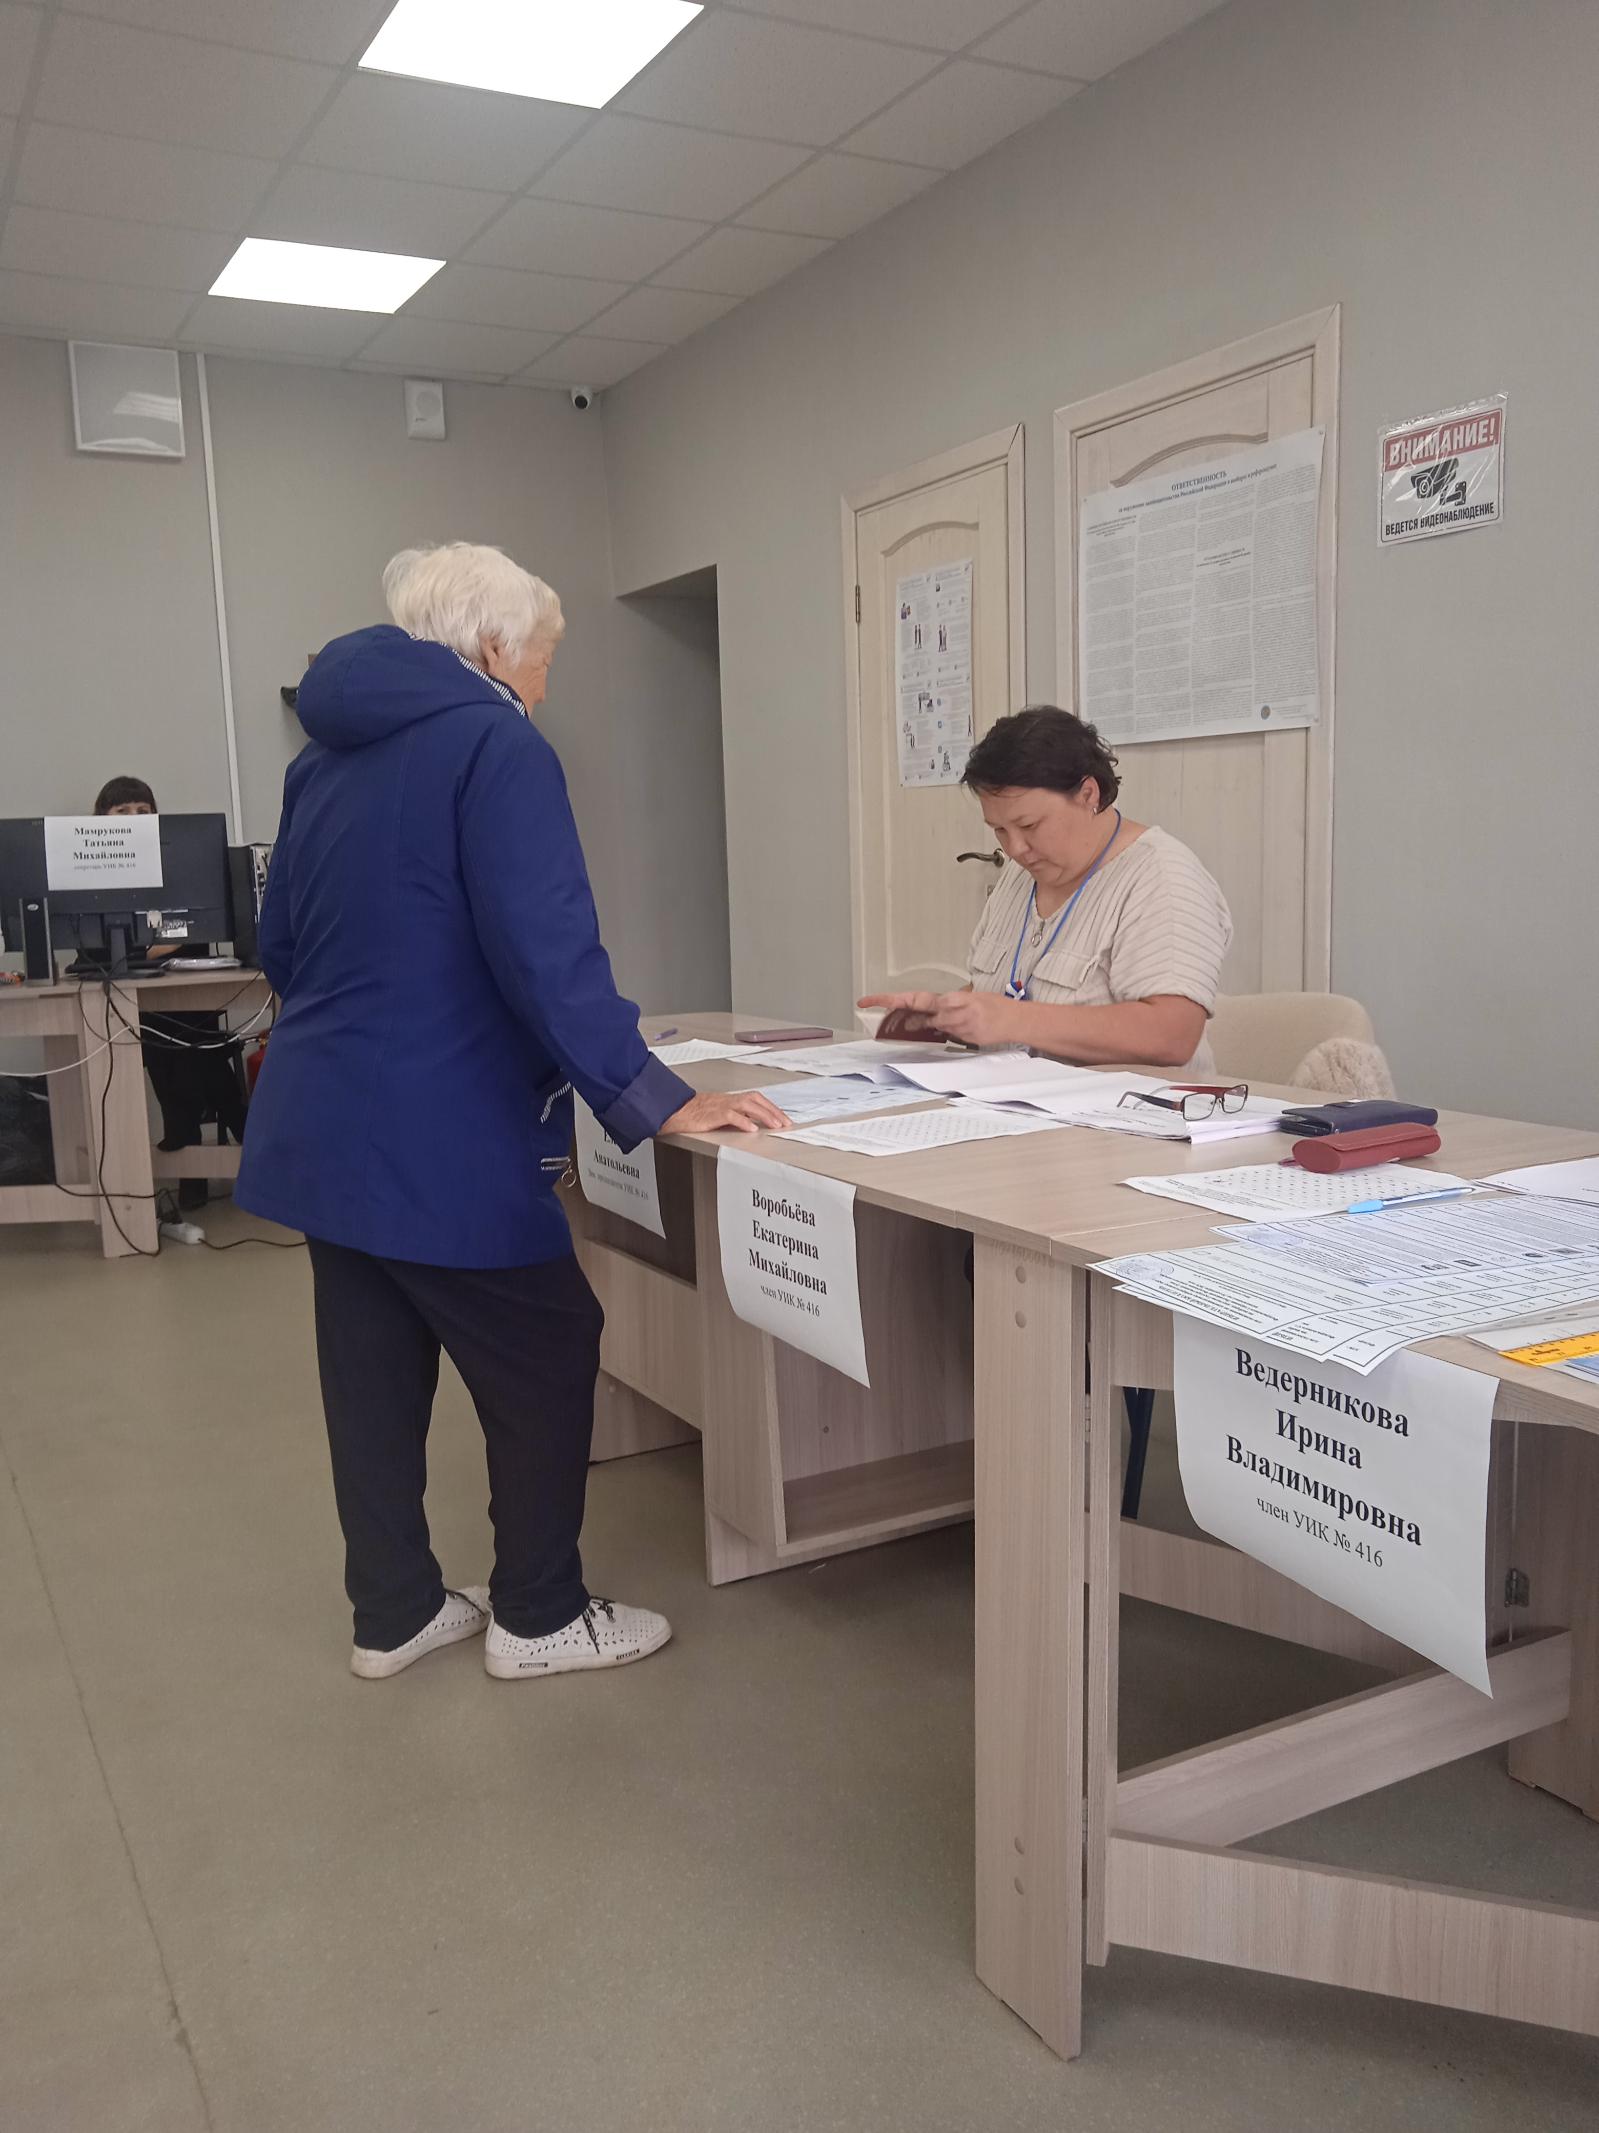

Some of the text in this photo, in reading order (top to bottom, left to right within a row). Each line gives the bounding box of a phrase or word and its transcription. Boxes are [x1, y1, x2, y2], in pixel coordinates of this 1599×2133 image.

[1389, 417, 1495, 466] ВНИМАНИЕ!
[1385, 502, 1495, 536] ВЕДЕТСЯ ВИДЕОНАБЛЮДЕНИЕ
[73, 851, 136, 860] Михайловна
[83, 839, 124, 847] Татьяна
[594, 1149, 640, 1179] Анатольевна
[752, 1189, 816, 1227] Воробьёва
[752, 1220, 819, 1259] Екатерина
[749, 1248, 827, 1295] Михайловна
[761, 1285, 820, 1317] член УИК № 416
[1235, 1347, 1410, 1438] Ведерникова
[1276, 1408, 1363, 1470] Ирина
[1226, 1434, 1422, 1546] Владимировна
[1256, 1497, 1384, 1568] член УИК № 416
